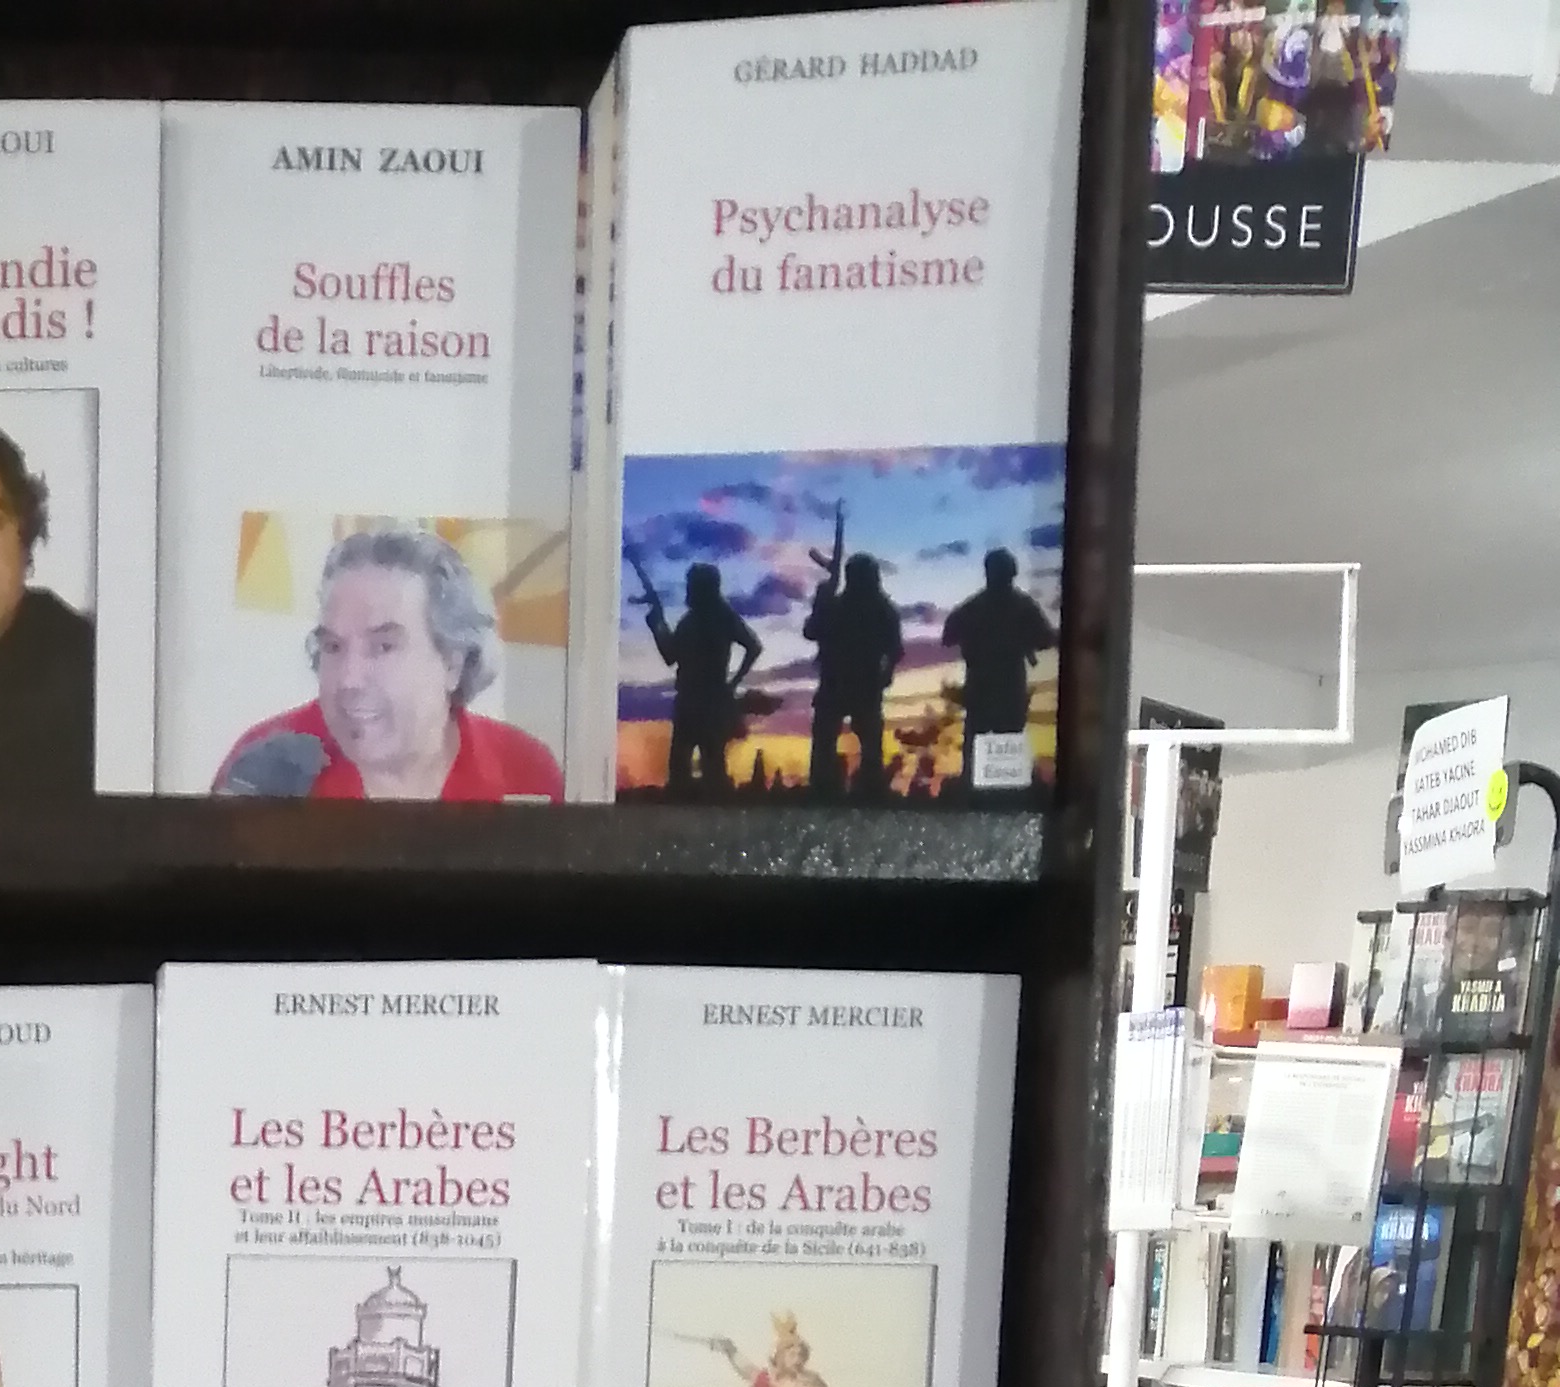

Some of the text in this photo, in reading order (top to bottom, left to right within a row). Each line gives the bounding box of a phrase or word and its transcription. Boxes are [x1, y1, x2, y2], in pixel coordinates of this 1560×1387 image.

[734, 46, 978, 83] GÉRARD HADDAD
[272, 145, 485, 174] AMIN ZAOUI
[713, 187, 991, 243] Psychanalyse
[293, 261, 456, 302] Souffles
[711, 249, 985, 294] du fanatisme
[84, 298, 95, 340] !
[256, 314, 491, 359] de la raison
[1459, 728, 1477, 749] DIB
[1415, 760, 1476, 794] KATEB YACINE
[1412, 789, 1480, 823] TAHAR DJAOUT
[1404, 819, 1485, 856] YASSMINA KHADRA
[274, 993, 499, 1016] ERNEST MERCIER
[703, 1003, 924, 1028] ERNEST MERCIER
[231, 1107, 517, 1150] Les Berbères
[657, 1114, 938, 1157] Les Berbères
[230, 1162, 511, 1206] et les Arabes
[655, 1169, 932, 1213] et les Arabes
